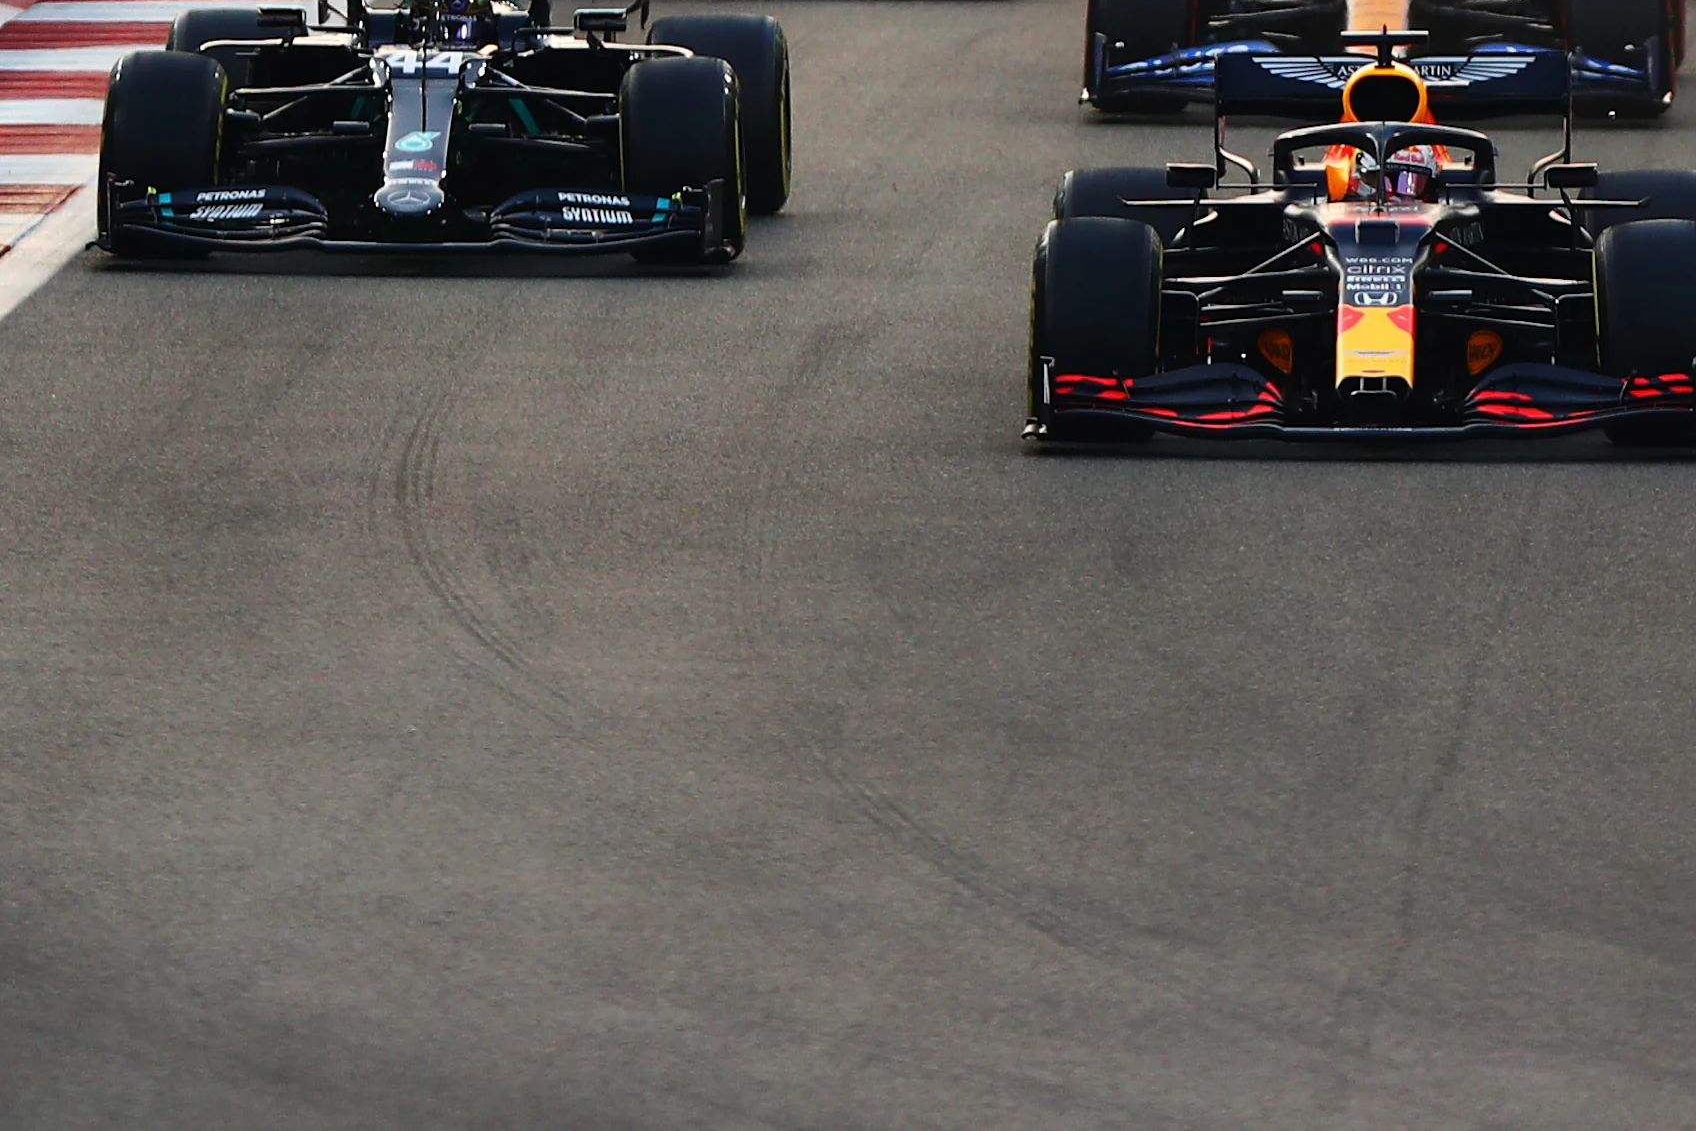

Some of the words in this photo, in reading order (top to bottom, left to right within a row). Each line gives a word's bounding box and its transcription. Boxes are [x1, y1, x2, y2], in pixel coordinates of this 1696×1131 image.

[387, 51, 464, 75] 44
[196, 188, 267, 202] PETRONAS
[557, 191, 631, 207] PETRONAS
[562, 206, 634, 224] SYNTIUM
